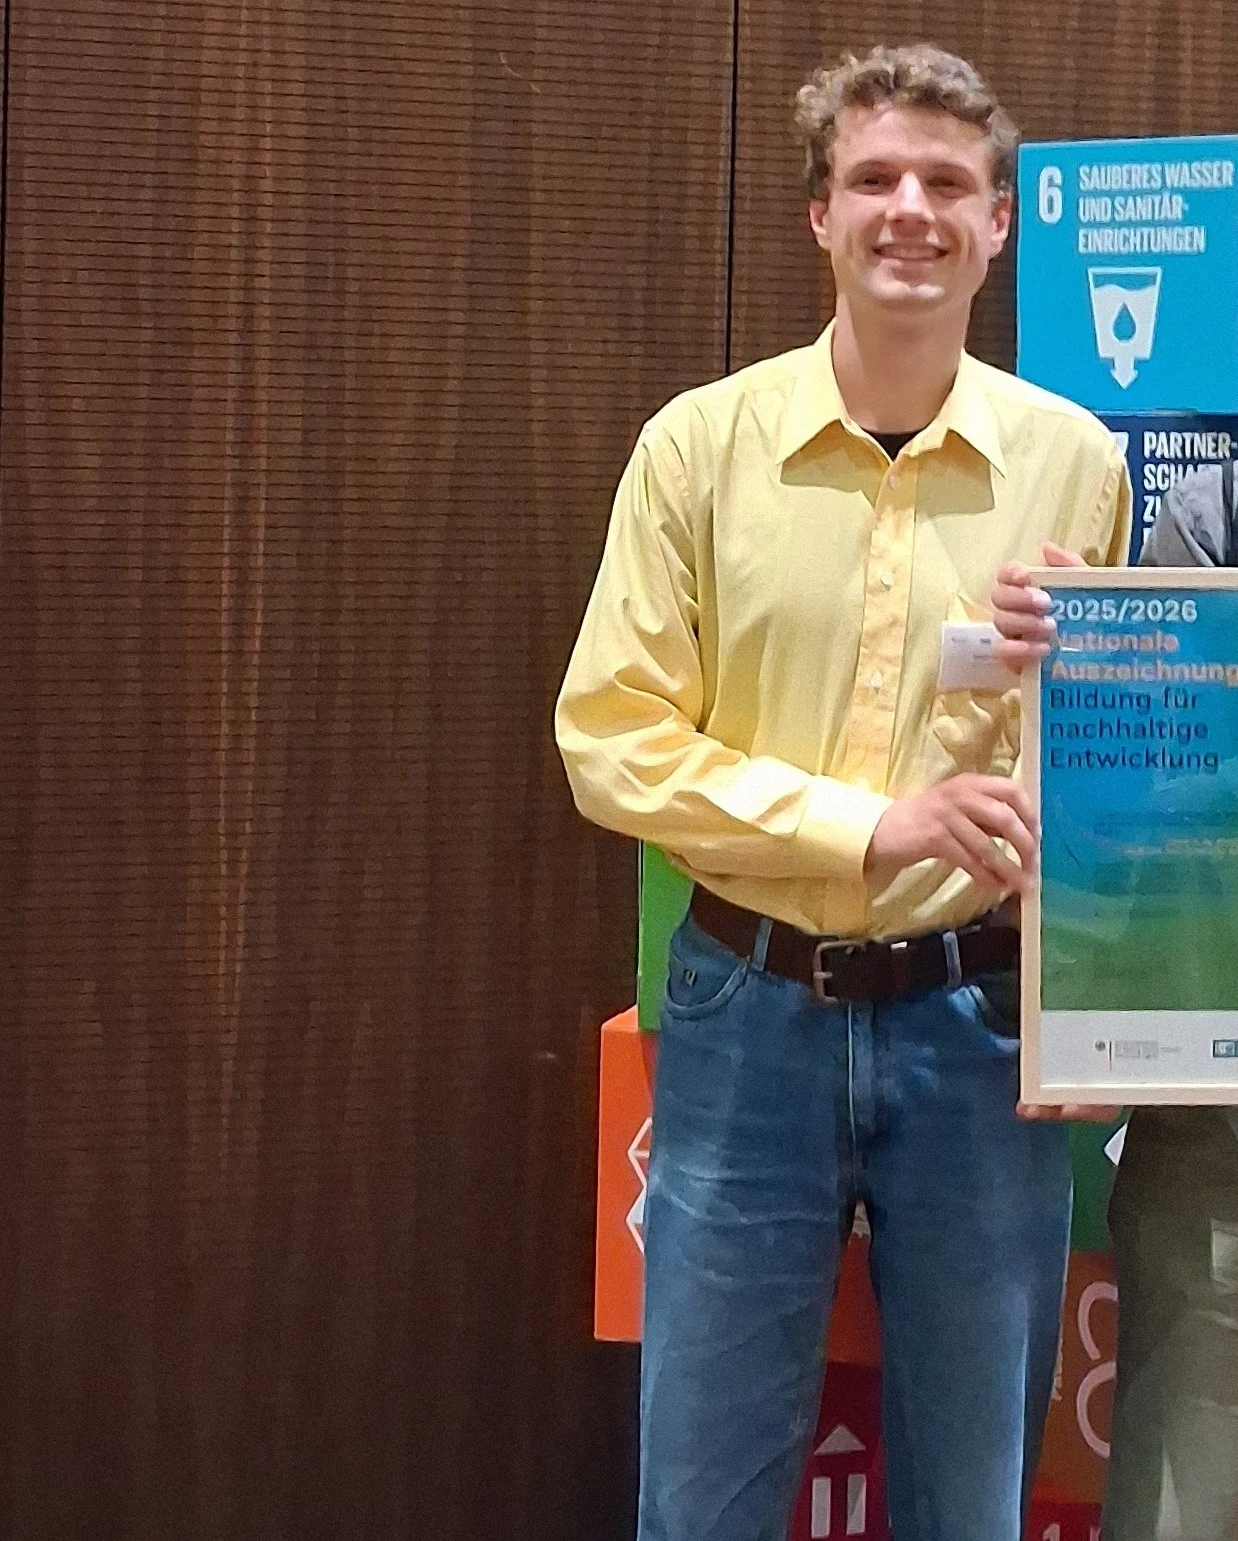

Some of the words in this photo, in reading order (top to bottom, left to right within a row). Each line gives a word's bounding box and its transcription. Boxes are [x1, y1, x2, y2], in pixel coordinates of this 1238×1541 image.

[1079, 163, 1162, 191] SAUBERES
[1164, 160, 1235, 188] WASSER
[1038, 166, 1062, 224] 6
[1078, 195, 1112, 222] UND
[1078, 226, 1207, 254] EINRICHTUNGEN
[1143, 431, 1238, 460] PARTNER-
[1052, 598, 1198, 623] 2025/2026
[1050, 686, 1152, 715] Bildung
[1163, 685, 1199, 709] für
[1050, 716, 1209, 745] nachhaltige
[1050, 746, 1219, 775] Entwicklung
